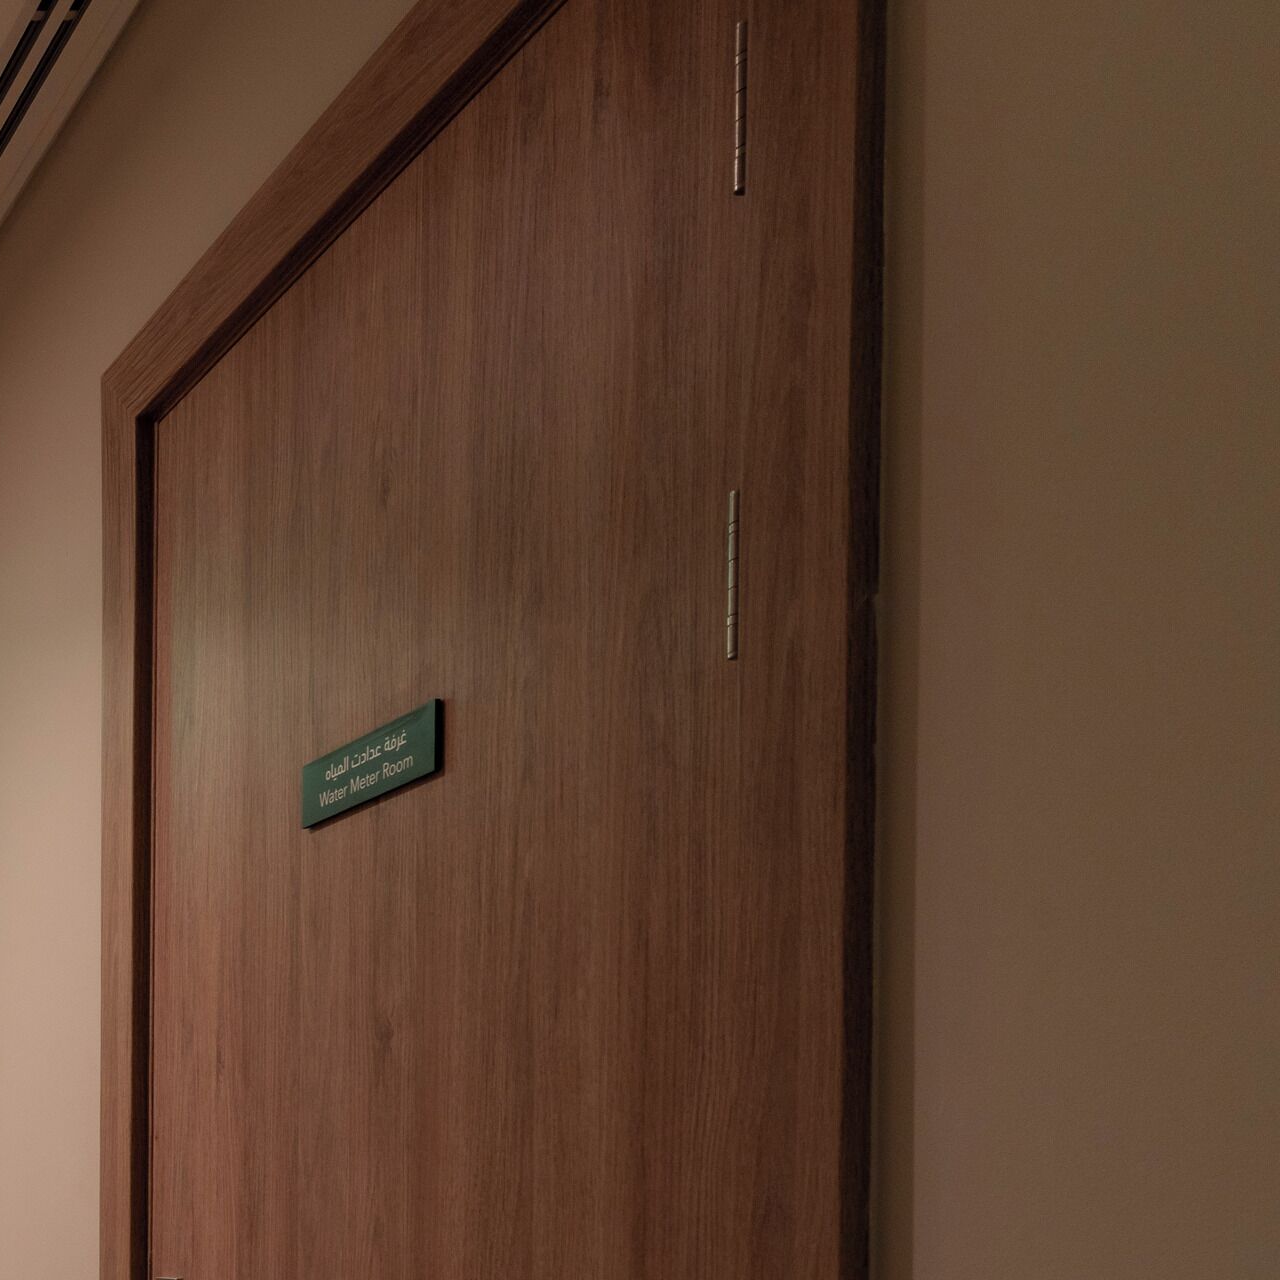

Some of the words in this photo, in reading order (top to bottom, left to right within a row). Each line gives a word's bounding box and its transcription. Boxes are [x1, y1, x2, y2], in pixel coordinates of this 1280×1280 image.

[383, 729, 407, 752] غرفة
[319, 785, 348, 807] Water
[350, 770, 380, 794] Meter
[382, 755, 414, 779] Room
[325, 755, 349, 782] المياه
